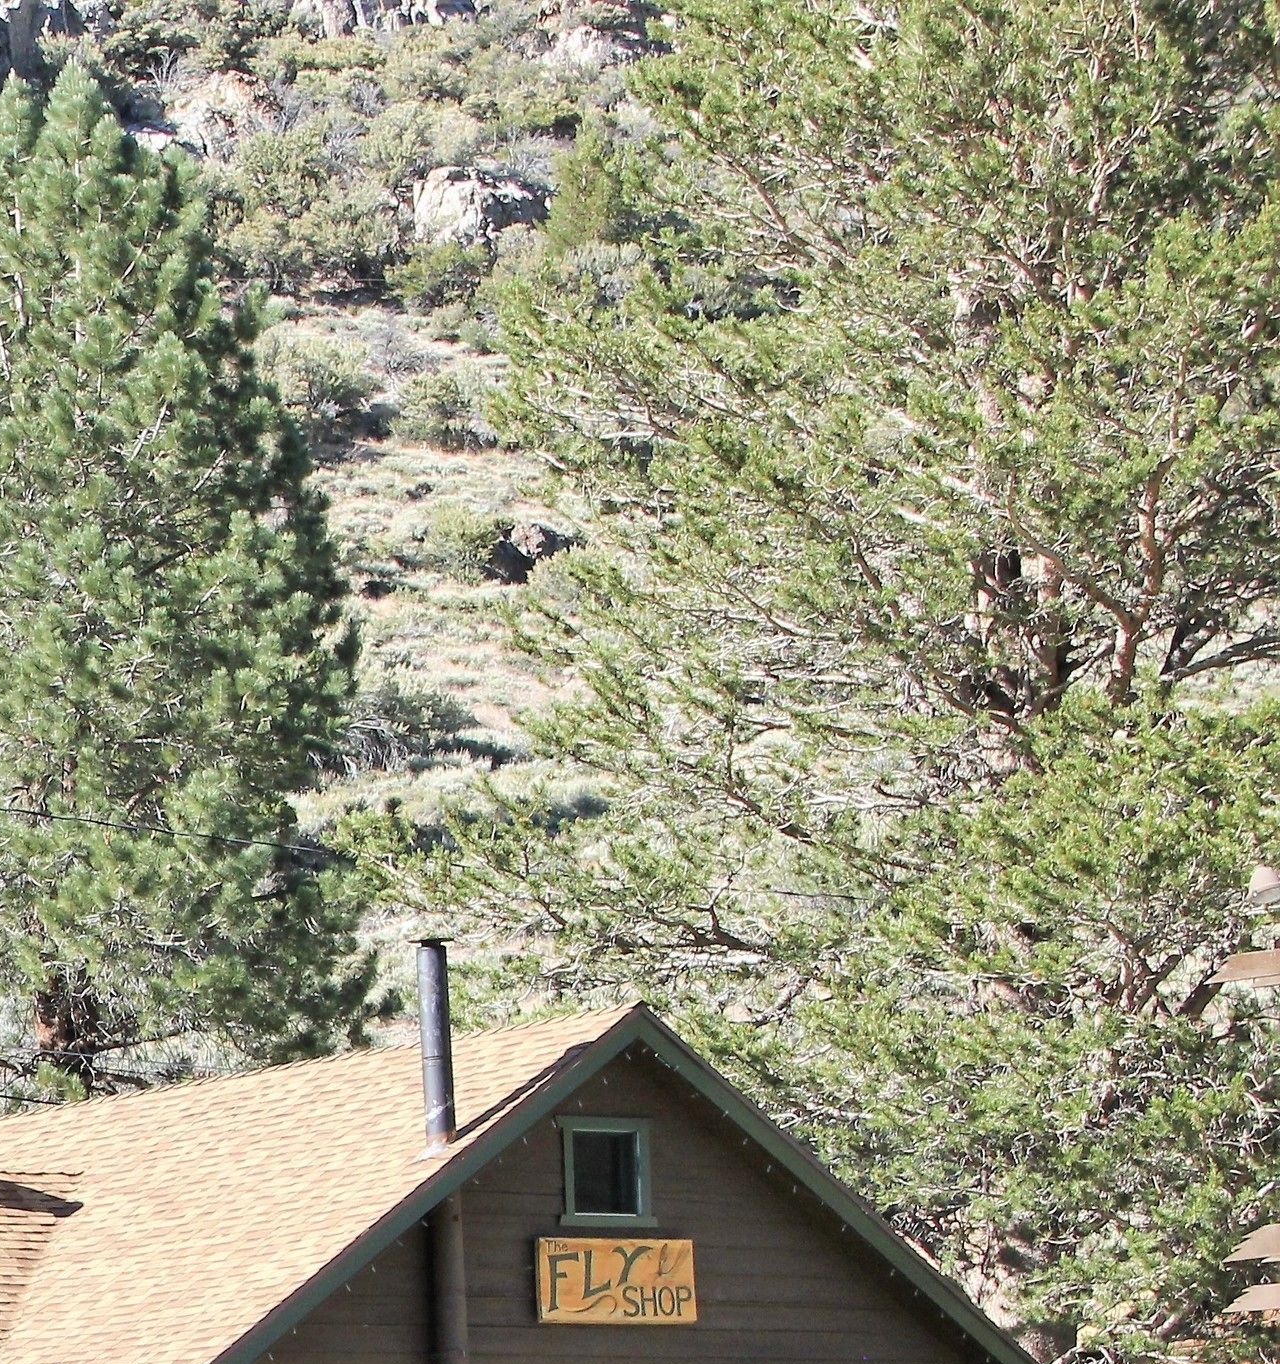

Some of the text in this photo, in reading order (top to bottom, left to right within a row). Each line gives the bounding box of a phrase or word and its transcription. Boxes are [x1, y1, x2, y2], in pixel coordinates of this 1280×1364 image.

[545, 1240, 569, 1252] The
[547, 1246, 653, 1312] FLY
[622, 1285, 692, 1317] SHOP
